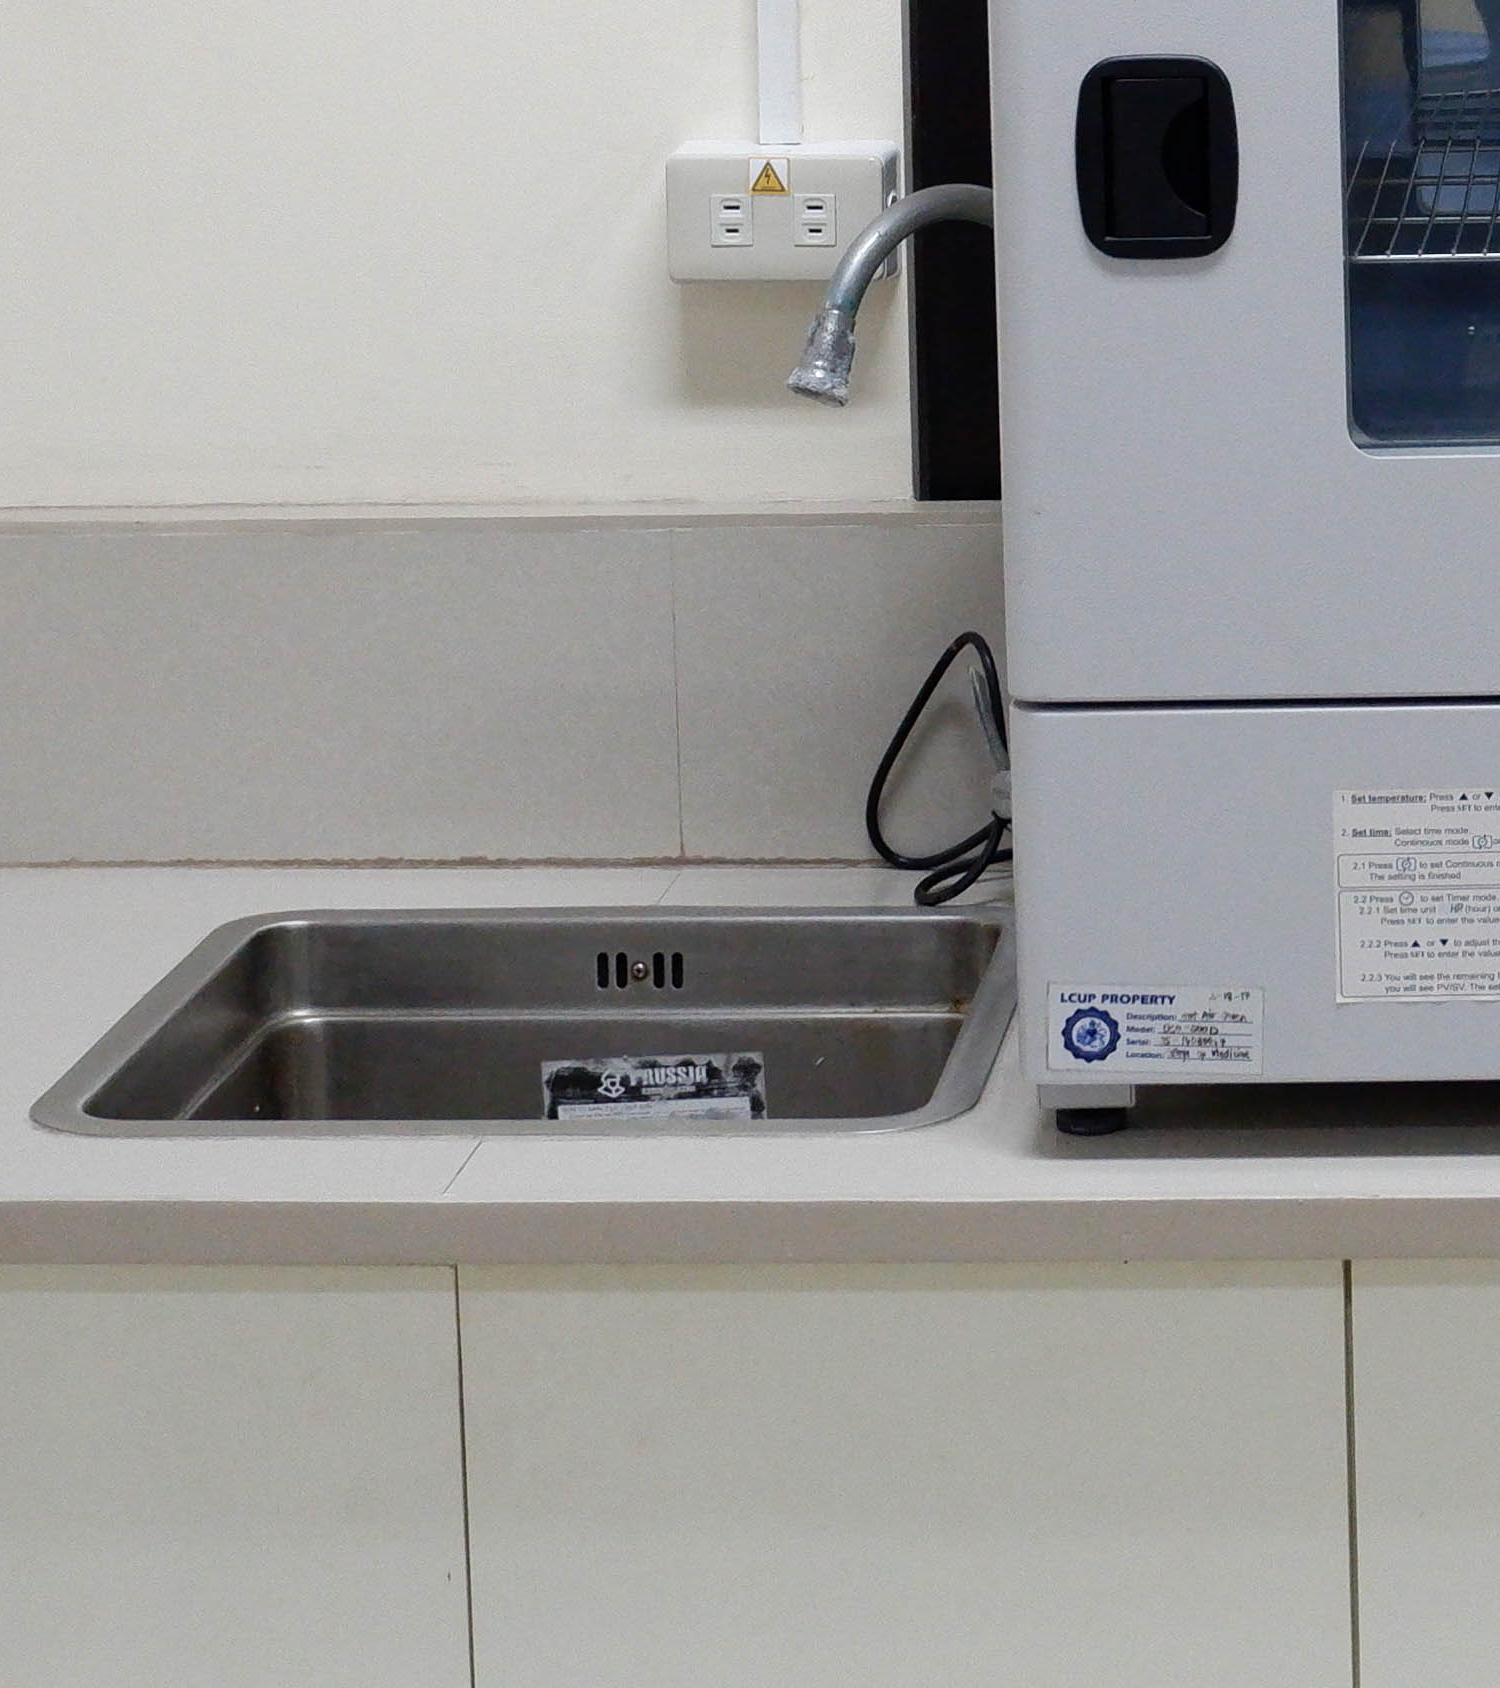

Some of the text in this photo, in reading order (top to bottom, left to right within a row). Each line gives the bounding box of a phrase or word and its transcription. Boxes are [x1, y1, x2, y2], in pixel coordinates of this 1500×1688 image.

[1429, 792, 1454, 801] Press
[1431, 804, 1455, 812] Press
[1473, 804, 1482, 812] to
[1351, 828, 1367, 837] Set
[1394, 827, 1422, 835] Select
[1424, 826, 1442, 835] time
[1394, 838, 1443, 847] Continuous
[1445, 837, 1470, 846] mode
[1352, 862, 1366, 870] 2.1
[1368, 861, 1393, 870] Press
[1419, 861, 1428, 869] to
[1445, 859, 1494, 868] Continuous
[1369, 872, 1385, 880] The
[1388, 872, 1416, 881] setting
[1418, 872, 1426, 880] is
[1353, 895, 1368, 904] 2.2
[1419, 895, 1428, 903] to
[1431, 894, 1444, 902] set
[1446, 893, 1470, 902] Timer
[1453, 939, 1462, 947] to
[1384, 973, 1400, 981] You
[1436, 972, 1450, 980] the
[1470, 983, 1485, 991] The
[1060, 992, 1177, 1005] LCUP PROPERTY
